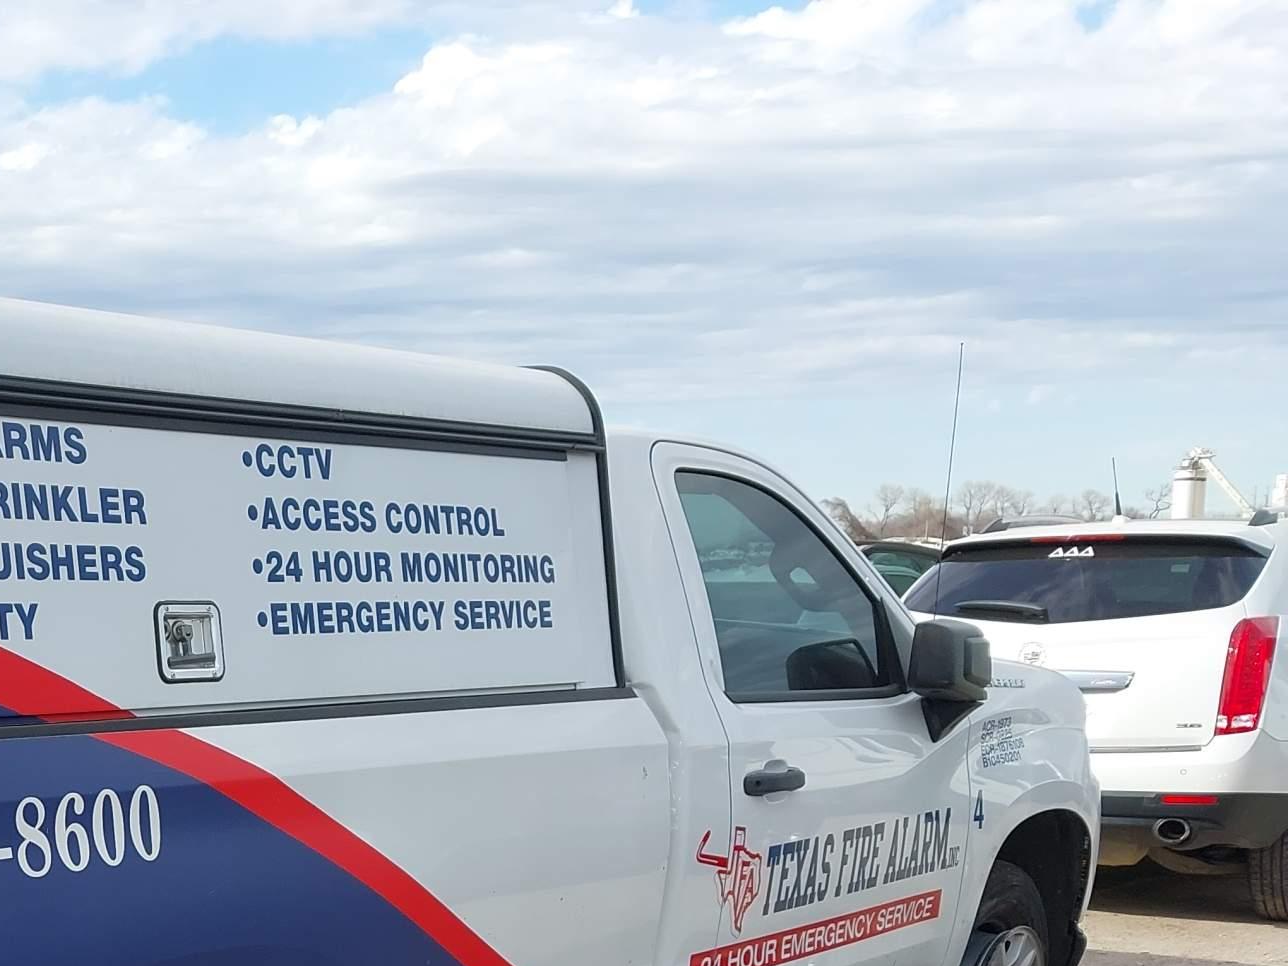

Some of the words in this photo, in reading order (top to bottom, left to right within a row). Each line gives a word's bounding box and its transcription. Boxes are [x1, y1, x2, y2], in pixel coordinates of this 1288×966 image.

[254, 443, 332, 481] CCTV
[261, 496, 377, 533] ACCESS
[384, 502, 506, 538] CONTROL
[266, 550, 303, 583] 24
[312, 550, 393, 584] HOUR
[400, 551, 556, 585] MONITORING
[269, 599, 445, 636] EMERGENCY
[454, 599, 554, 632] SERVICE
[973, 790, 985, 830] 4
[762, 832, 835, 916] TEXAS
[833, 821, 887, 898] FIRE
[780, 911, 876, 961] EMERGENCY
[875, 896, 935, 931] SERVICE
